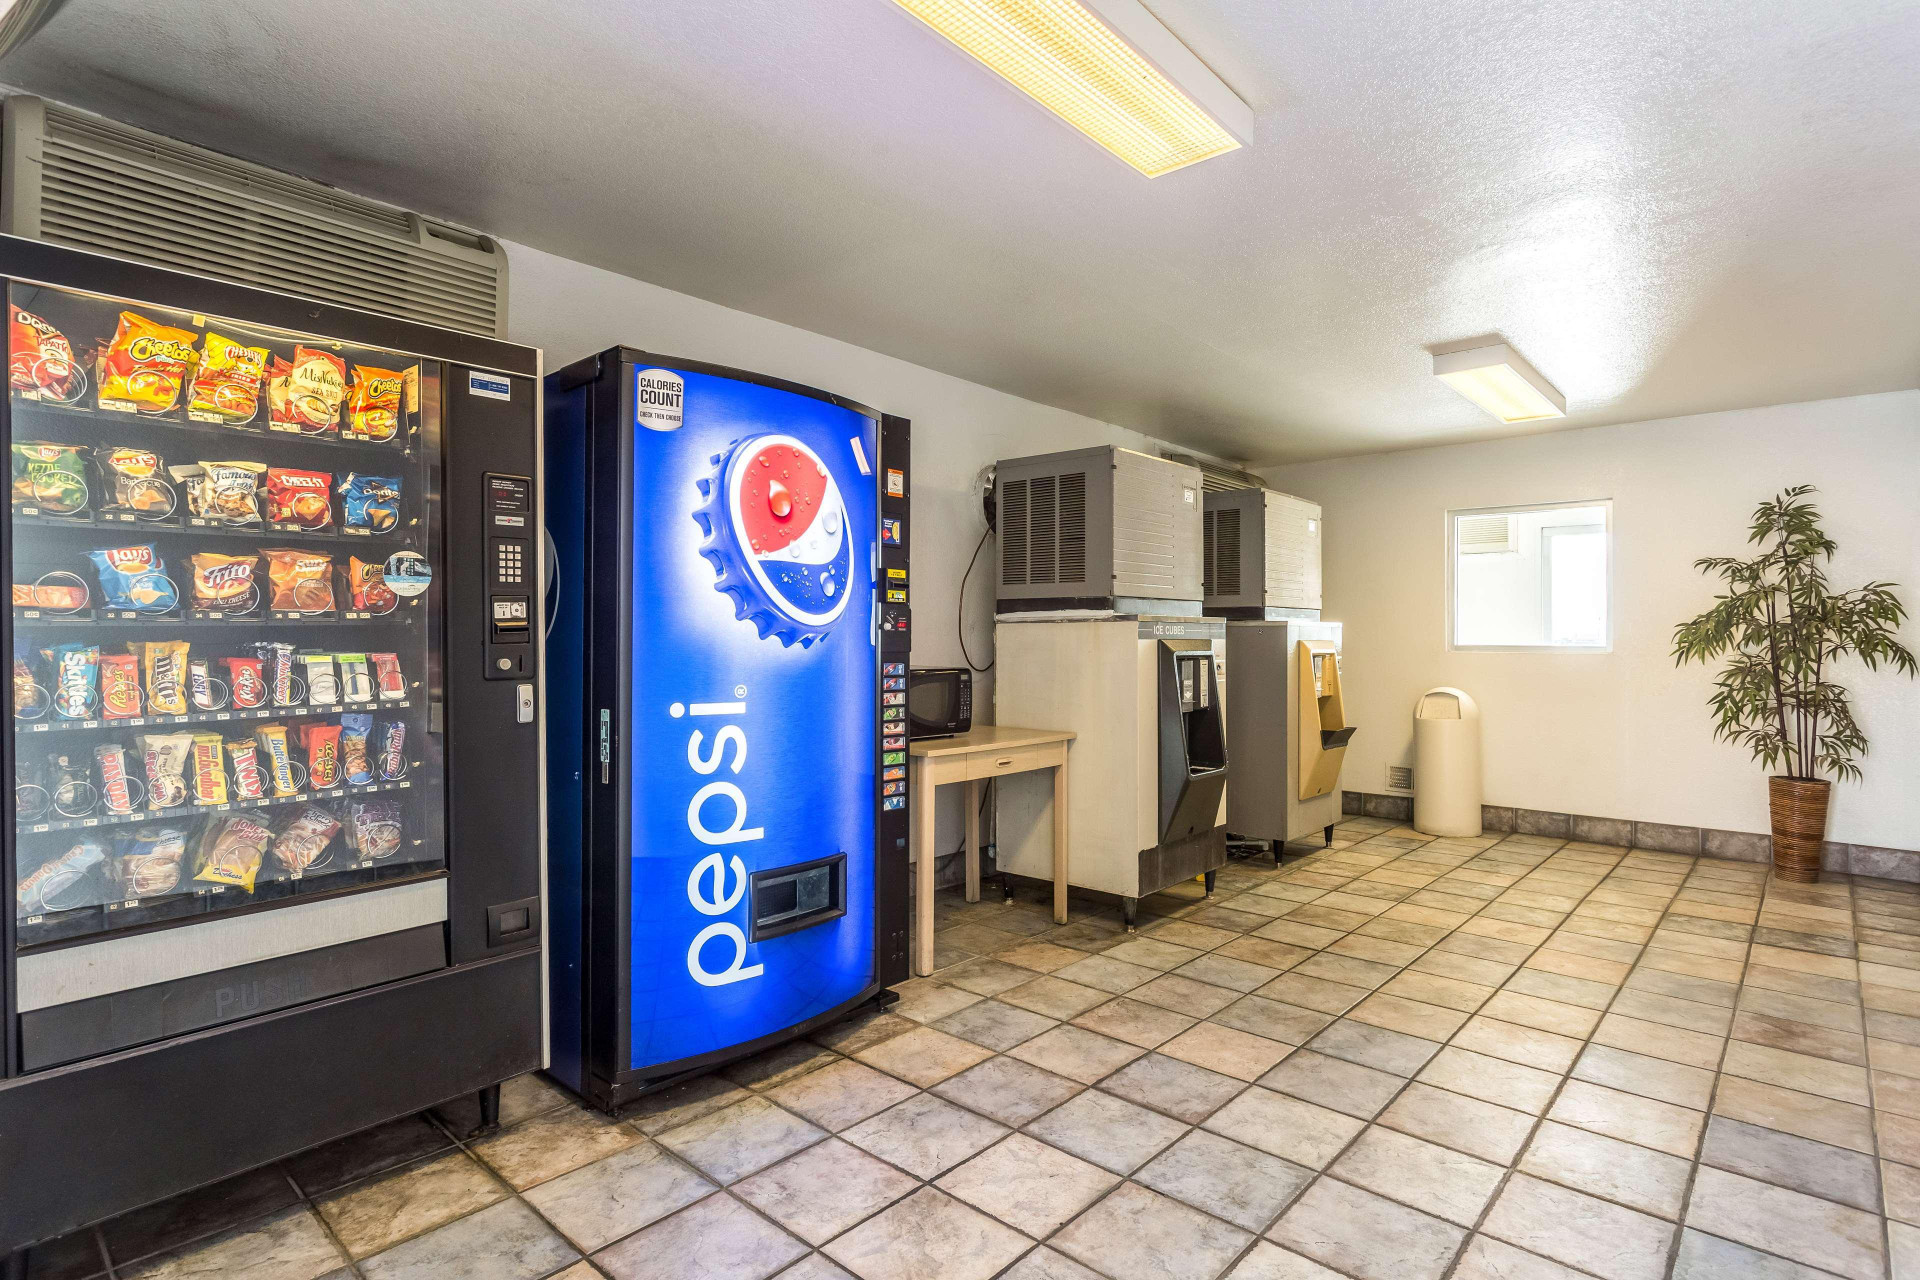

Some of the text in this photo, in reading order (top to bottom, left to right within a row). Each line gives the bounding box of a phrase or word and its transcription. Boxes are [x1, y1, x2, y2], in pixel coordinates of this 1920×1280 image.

[130, 337, 191, 361] Cheetos
[640, 377, 682, 393] CALORIES
[640, 389, 682, 408] COUNT
[640, 411, 653, 419] CHECK
[113, 549, 149, 565] Lay's
[1153, 625, 1185, 635] ICE CUBES
[64, 652, 88, 716] Skittles
[271, 738, 290, 789] Butterfinger
[103, 753, 131, 811] PAYDAY
[669, 701, 765, 987] pepsi
